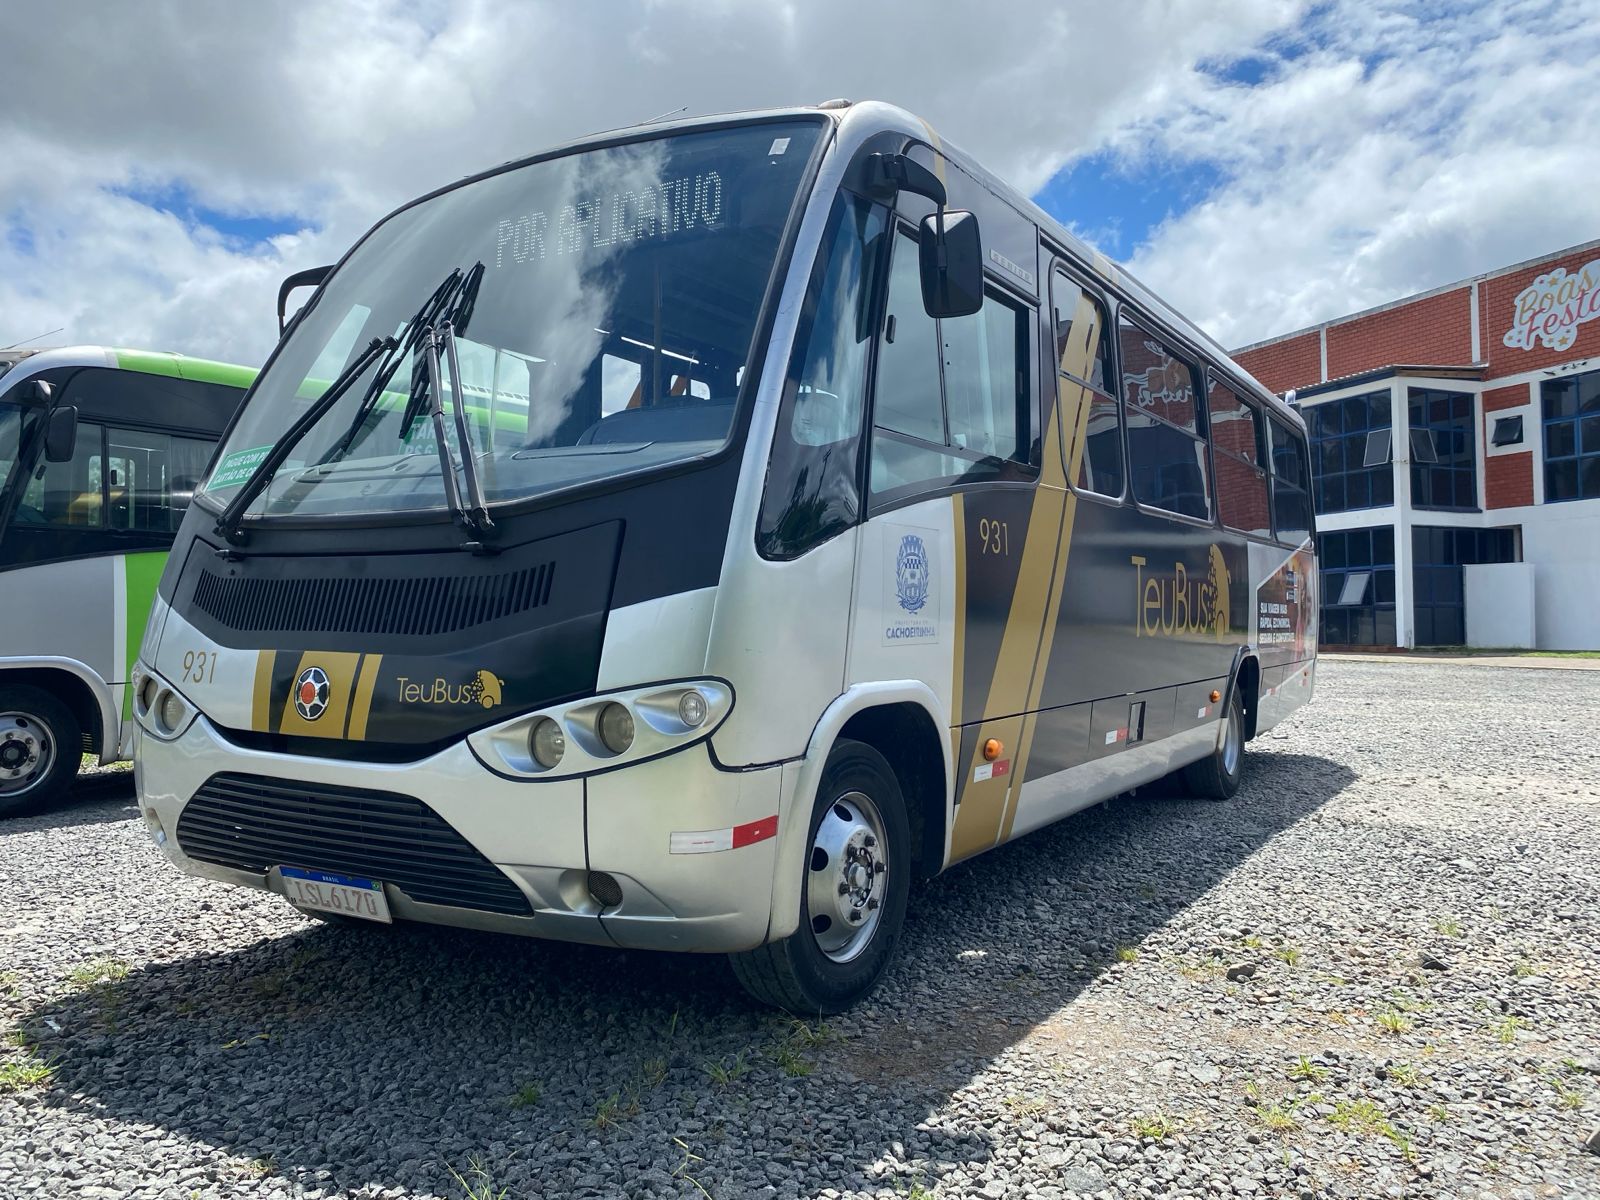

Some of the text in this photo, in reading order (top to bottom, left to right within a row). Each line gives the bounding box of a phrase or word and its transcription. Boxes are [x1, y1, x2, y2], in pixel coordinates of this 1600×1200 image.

[497, 171, 722, 268] POR APLICATIVO
[1518, 269, 1594, 326] Boas
[979, 518, 1008, 556] 931
[1131, 555, 1209, 638] TeuBus
[182, 650, 217, 684] 931
[396, 677, 472, 704] TeuBus
[321, 875, 340, 883] BRASIL
